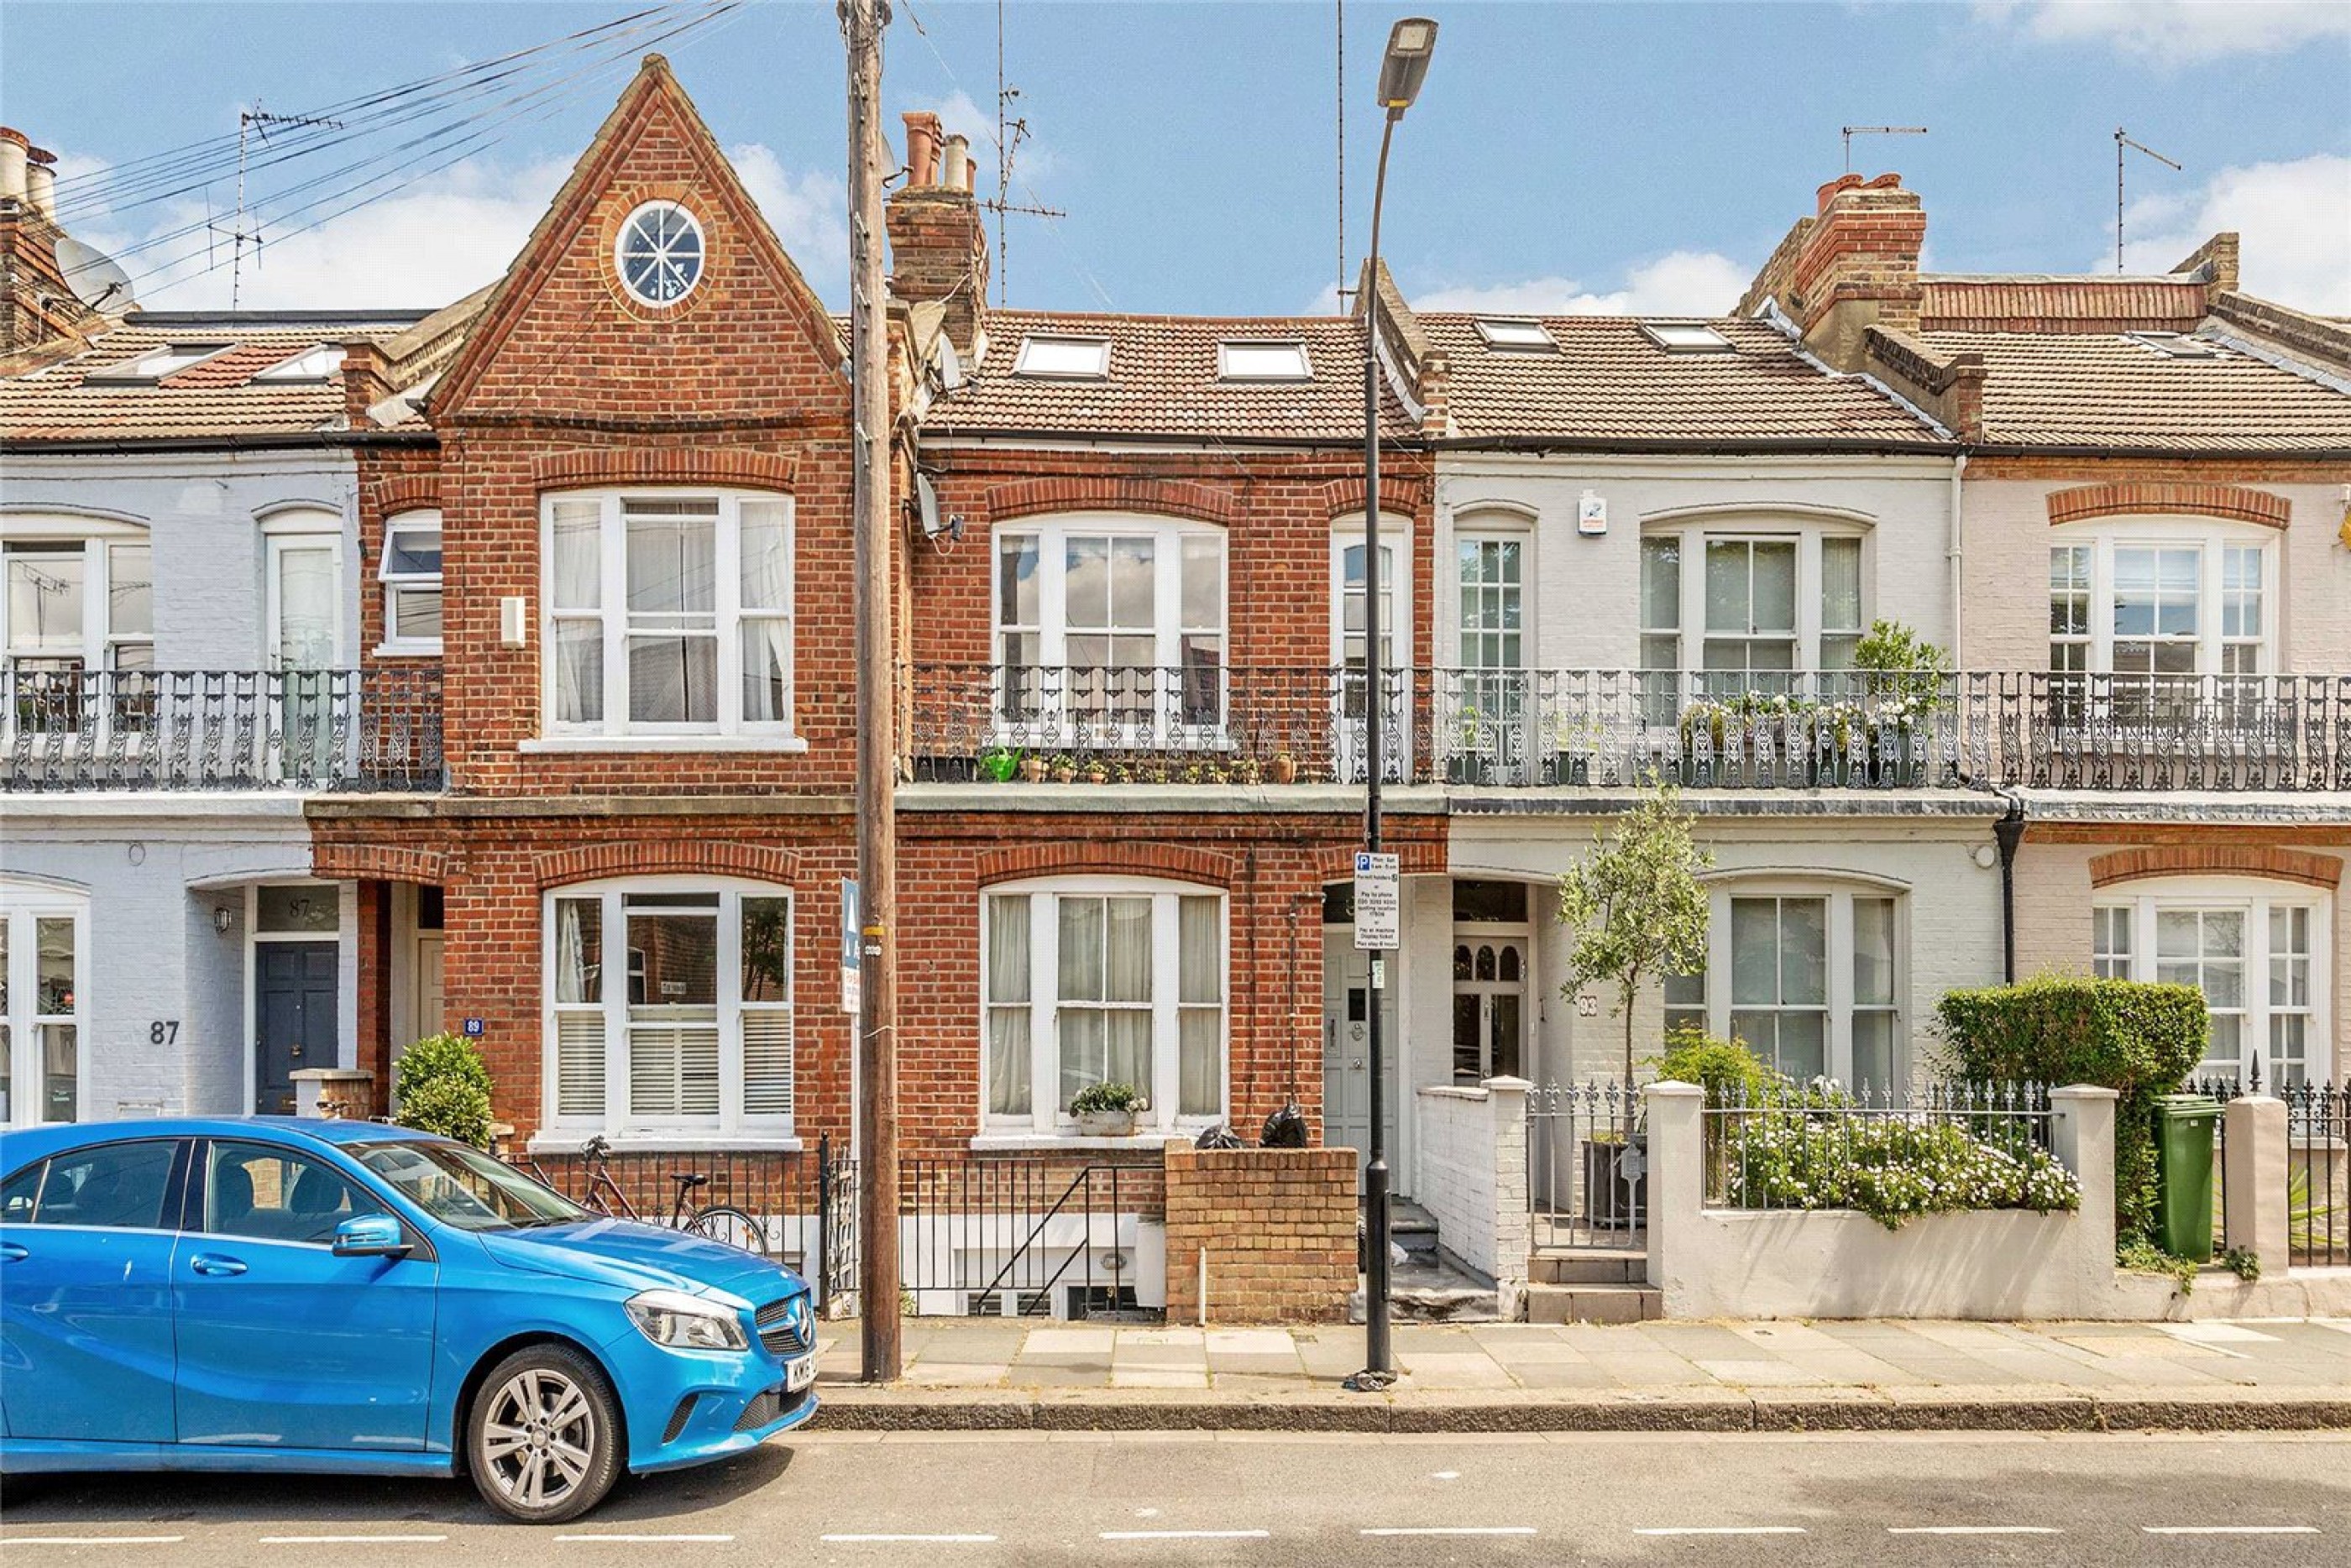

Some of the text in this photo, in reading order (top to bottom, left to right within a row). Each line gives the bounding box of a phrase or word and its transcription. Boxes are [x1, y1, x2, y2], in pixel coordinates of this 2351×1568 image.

[1360, 856, 1369, 870] P
[290, 898, 310, 917] 87
[151, 1021, 180, 1044] 87
[468, 1021, 479, 1032] 89
